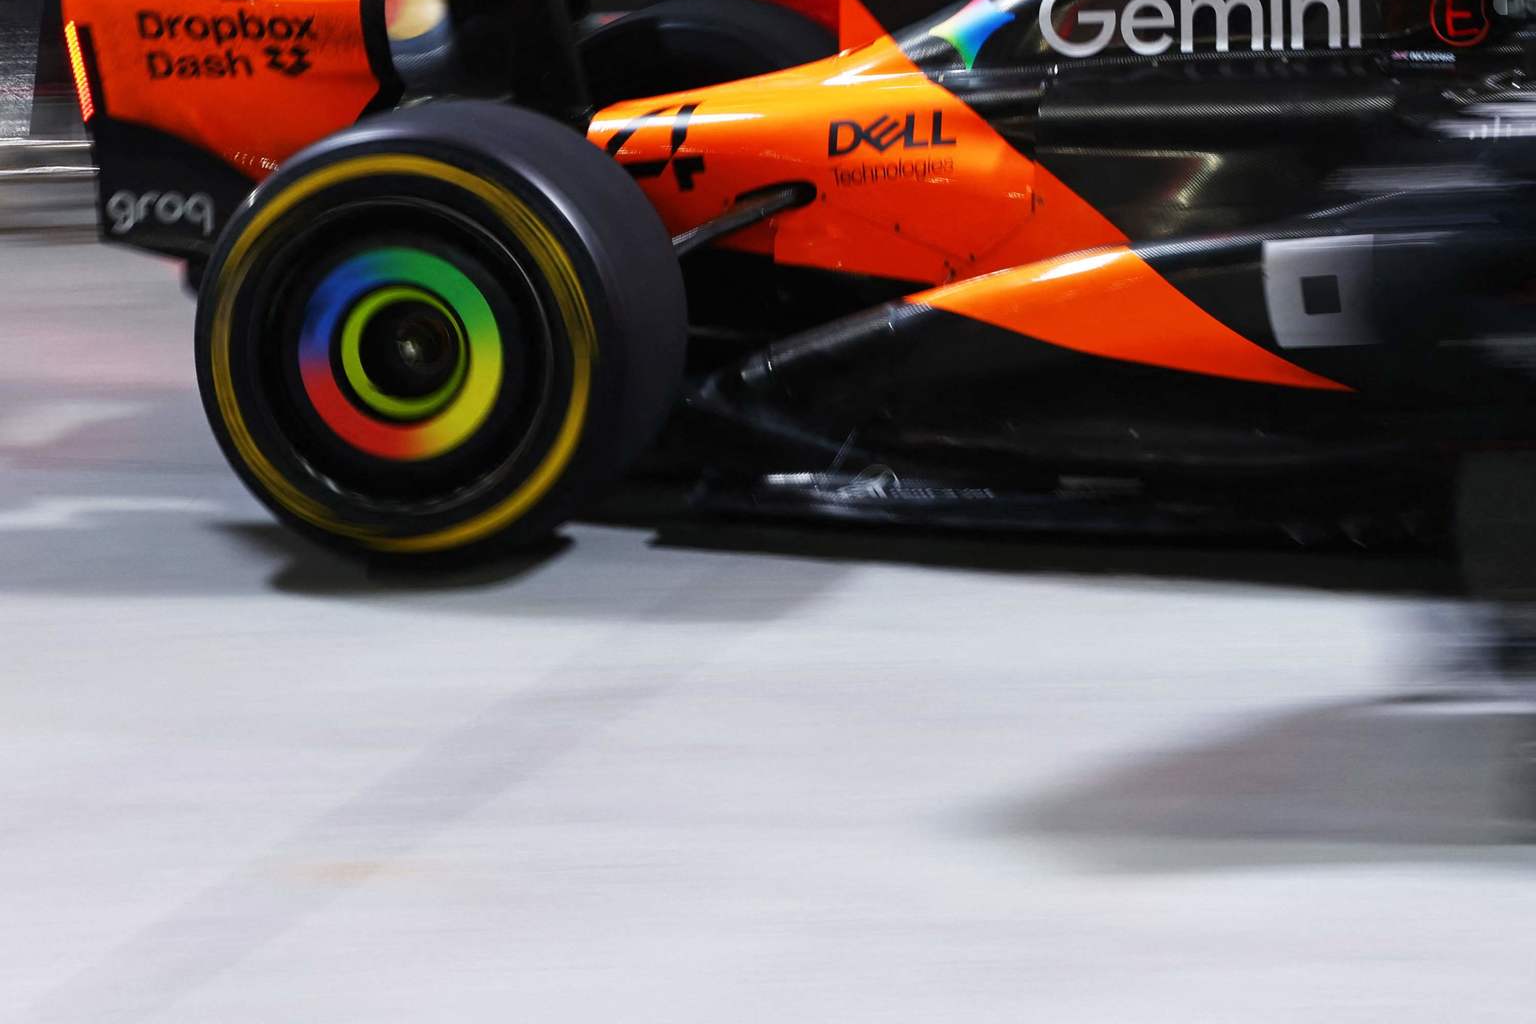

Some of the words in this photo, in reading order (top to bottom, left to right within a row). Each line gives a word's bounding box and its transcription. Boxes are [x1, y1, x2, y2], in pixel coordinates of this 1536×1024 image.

[137, 9, 318, 46] Dropbox
[148, 49, 254, 79] Dash
[829, 110, 957, 157] DELL
[831, 158, 955, 188] Technologies
[105, 190, 215, 236] groq
